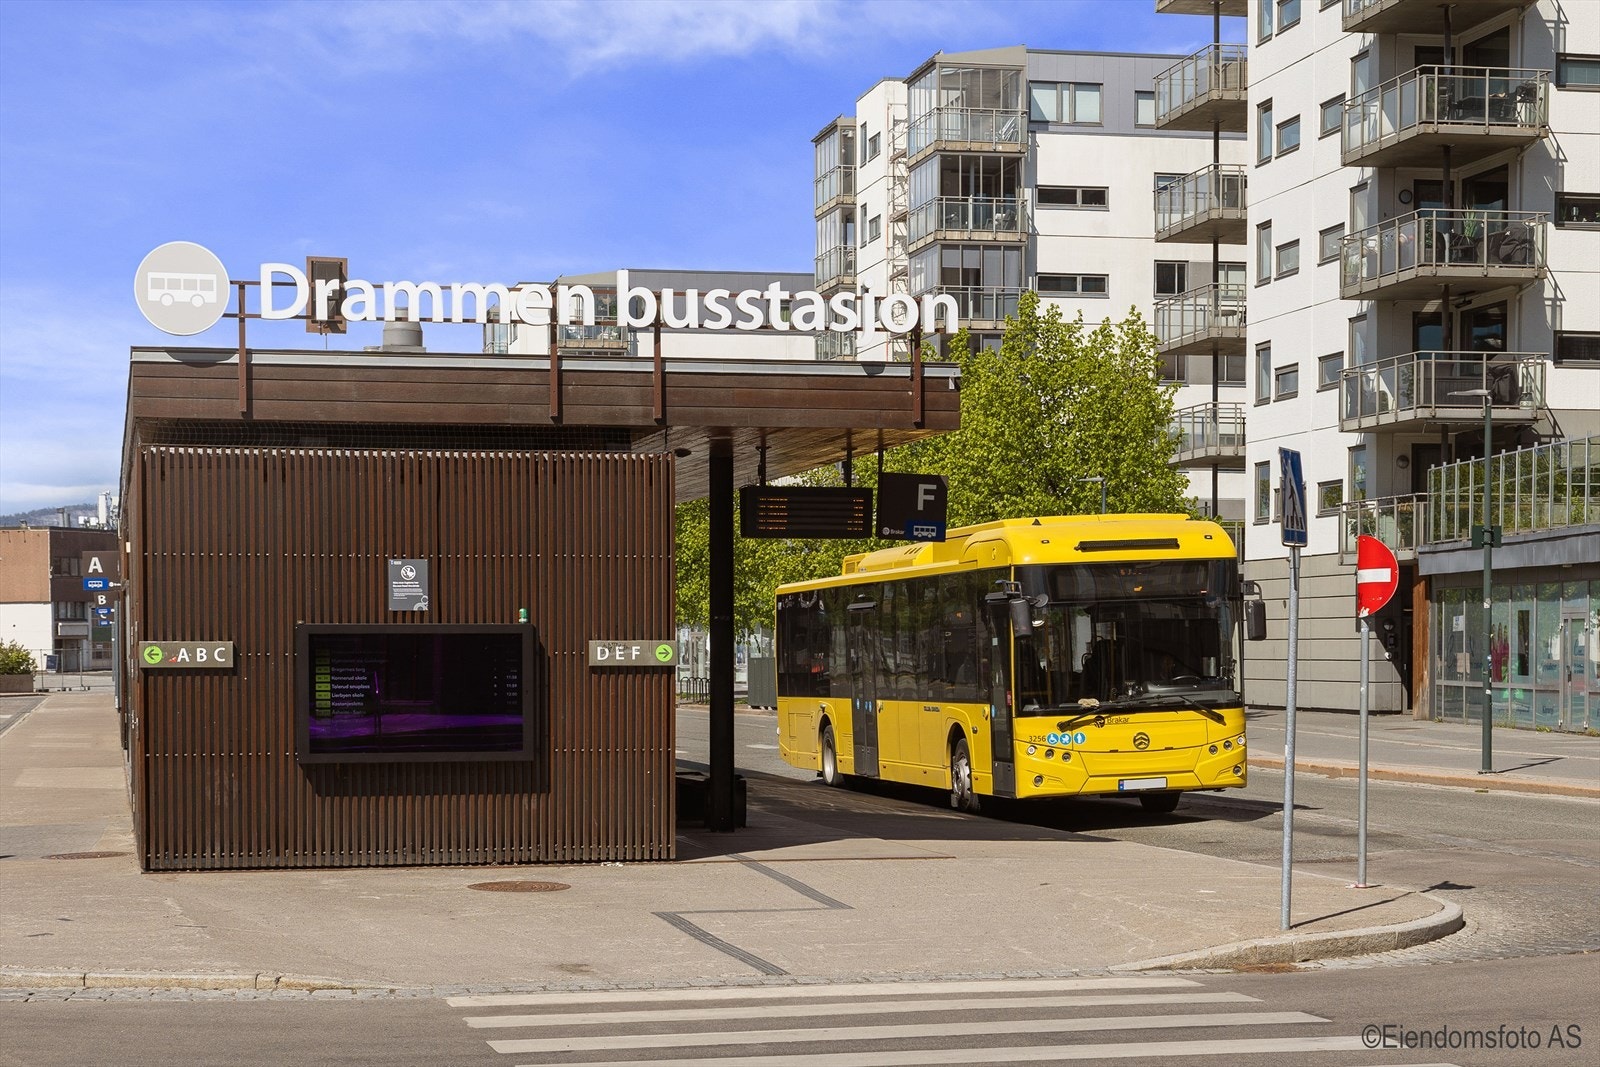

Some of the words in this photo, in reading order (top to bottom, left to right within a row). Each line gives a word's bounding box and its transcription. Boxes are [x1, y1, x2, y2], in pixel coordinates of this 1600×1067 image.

[260, 262, 595, 326] Drammen
[616, 269, 959, 347] busstasjon
[917, 483, 937, 511] F
[88, 557, 103, 573] A
[97, 594, 107, 605] B
[1107, 716, 1130, 724] Brakar
[1028, 735, 1047, 743] 3256
